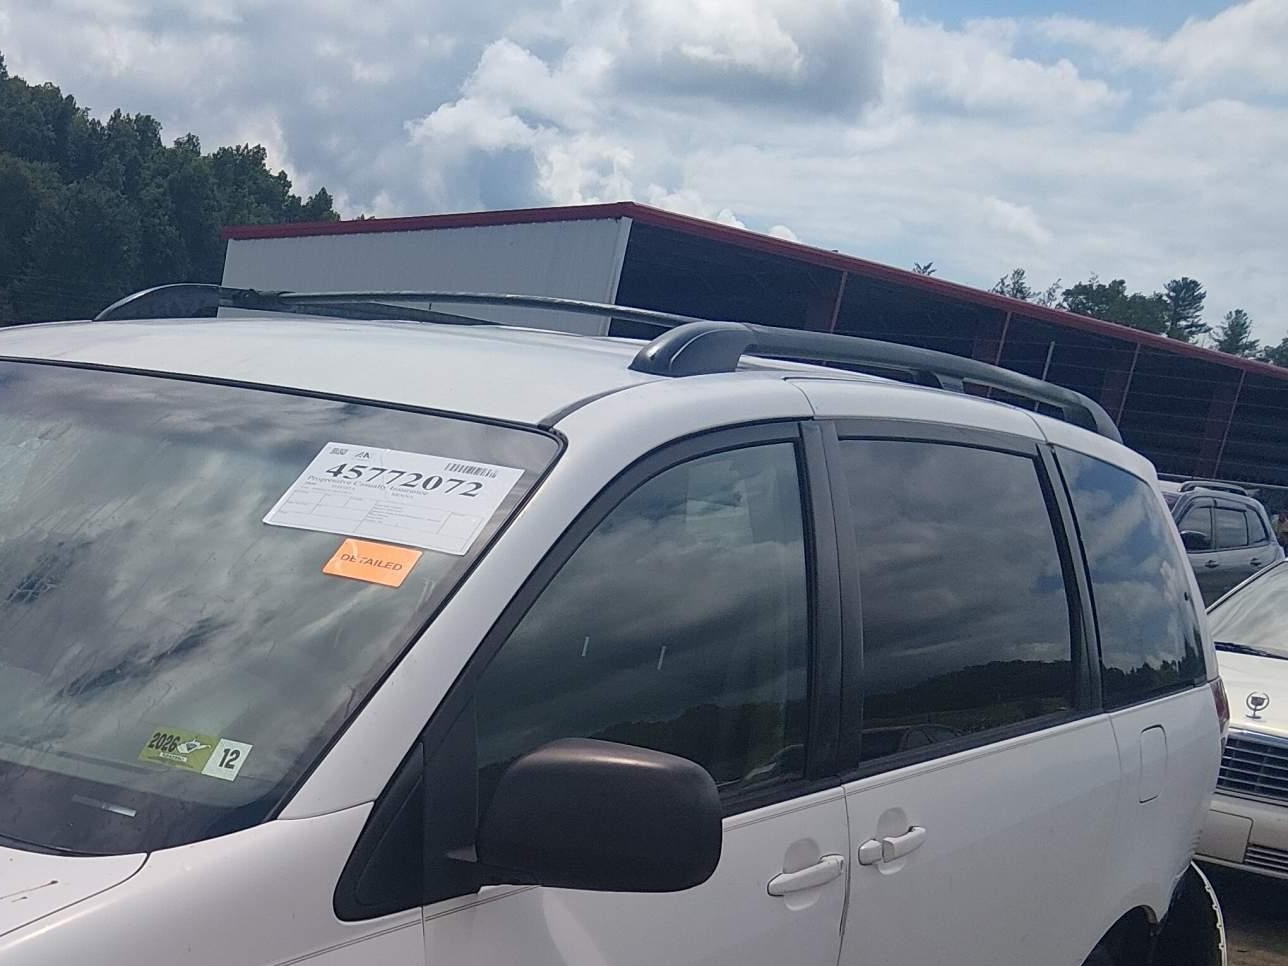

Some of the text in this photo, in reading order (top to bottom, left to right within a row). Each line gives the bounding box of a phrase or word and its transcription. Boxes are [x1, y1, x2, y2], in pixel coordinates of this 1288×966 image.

[326, 463, 483, 497] 45772072
[340, 553, 403, 571] DETAILED
[148, 732, 180, 753] 2026
[218, 748, 241, 769] 12
